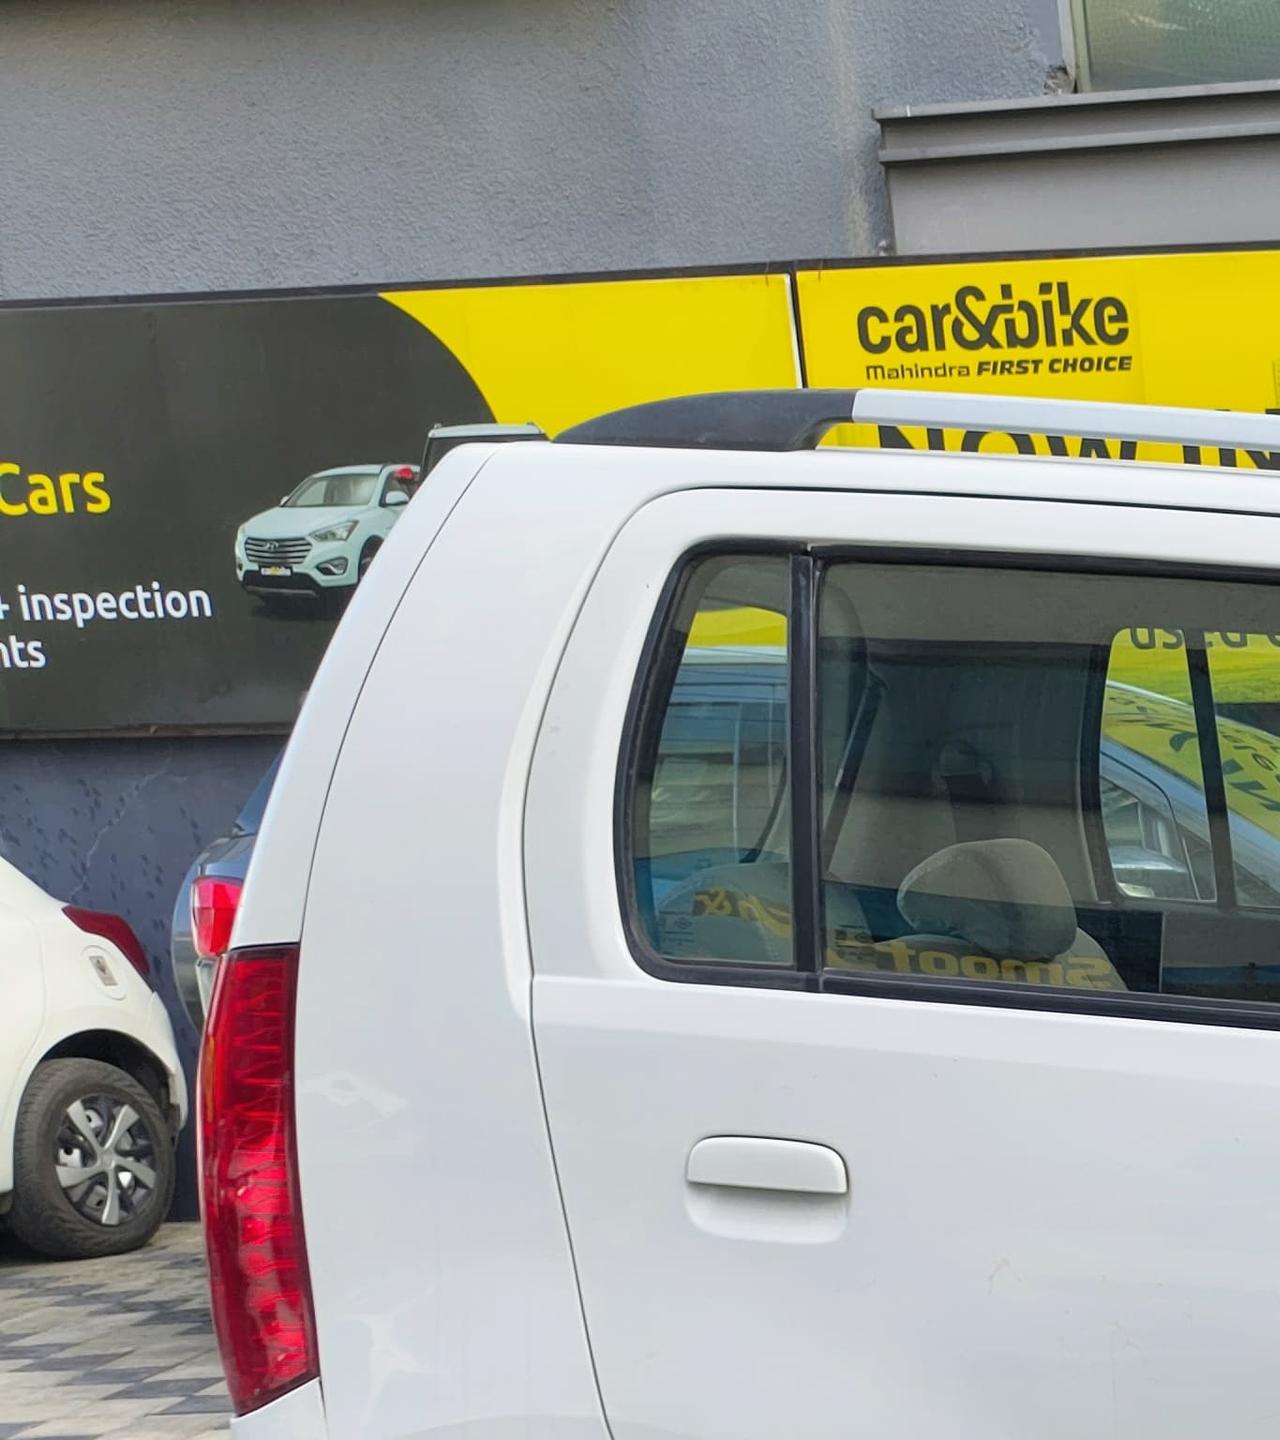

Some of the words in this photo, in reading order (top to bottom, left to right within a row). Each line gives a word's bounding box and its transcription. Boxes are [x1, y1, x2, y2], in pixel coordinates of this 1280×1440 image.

[857, 281, 1130, 354] car&bike
[866, 362, 970, 380] Mahindra
[977, 359, 1042, 376] FIRST
[1049, 356, 1133, 373] CHOICE
[0, 462, 111, 516] Cars
[17, 582, 213, 628] inspection
